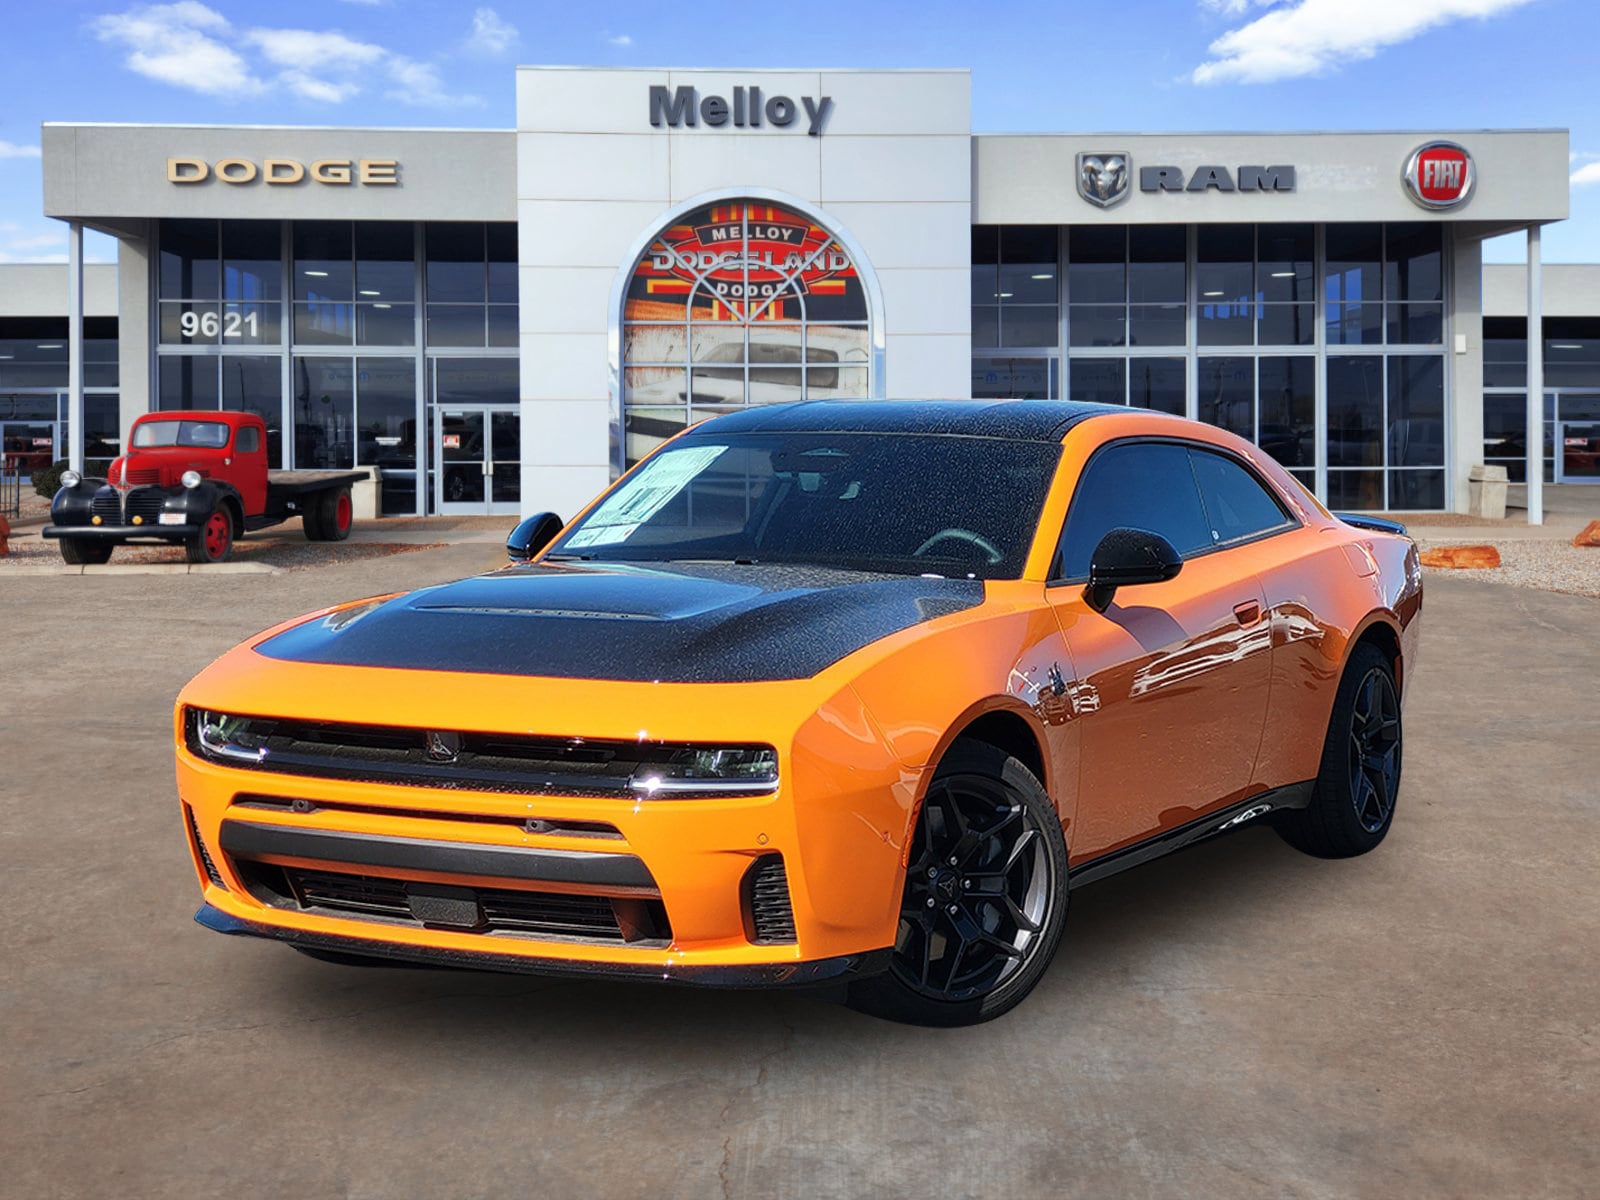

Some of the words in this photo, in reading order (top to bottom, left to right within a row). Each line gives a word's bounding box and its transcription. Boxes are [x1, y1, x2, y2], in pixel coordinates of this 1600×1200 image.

[649, 85, 832, 136] Melloy
[167, 159, 399, 184] DODGE
[1140, 165, 1296, 193] RAM
[1424, 159, 1464, 188] FIAT
[712, 226, 793, 241] MELOY
[181, 311, 258, 337] 9621
